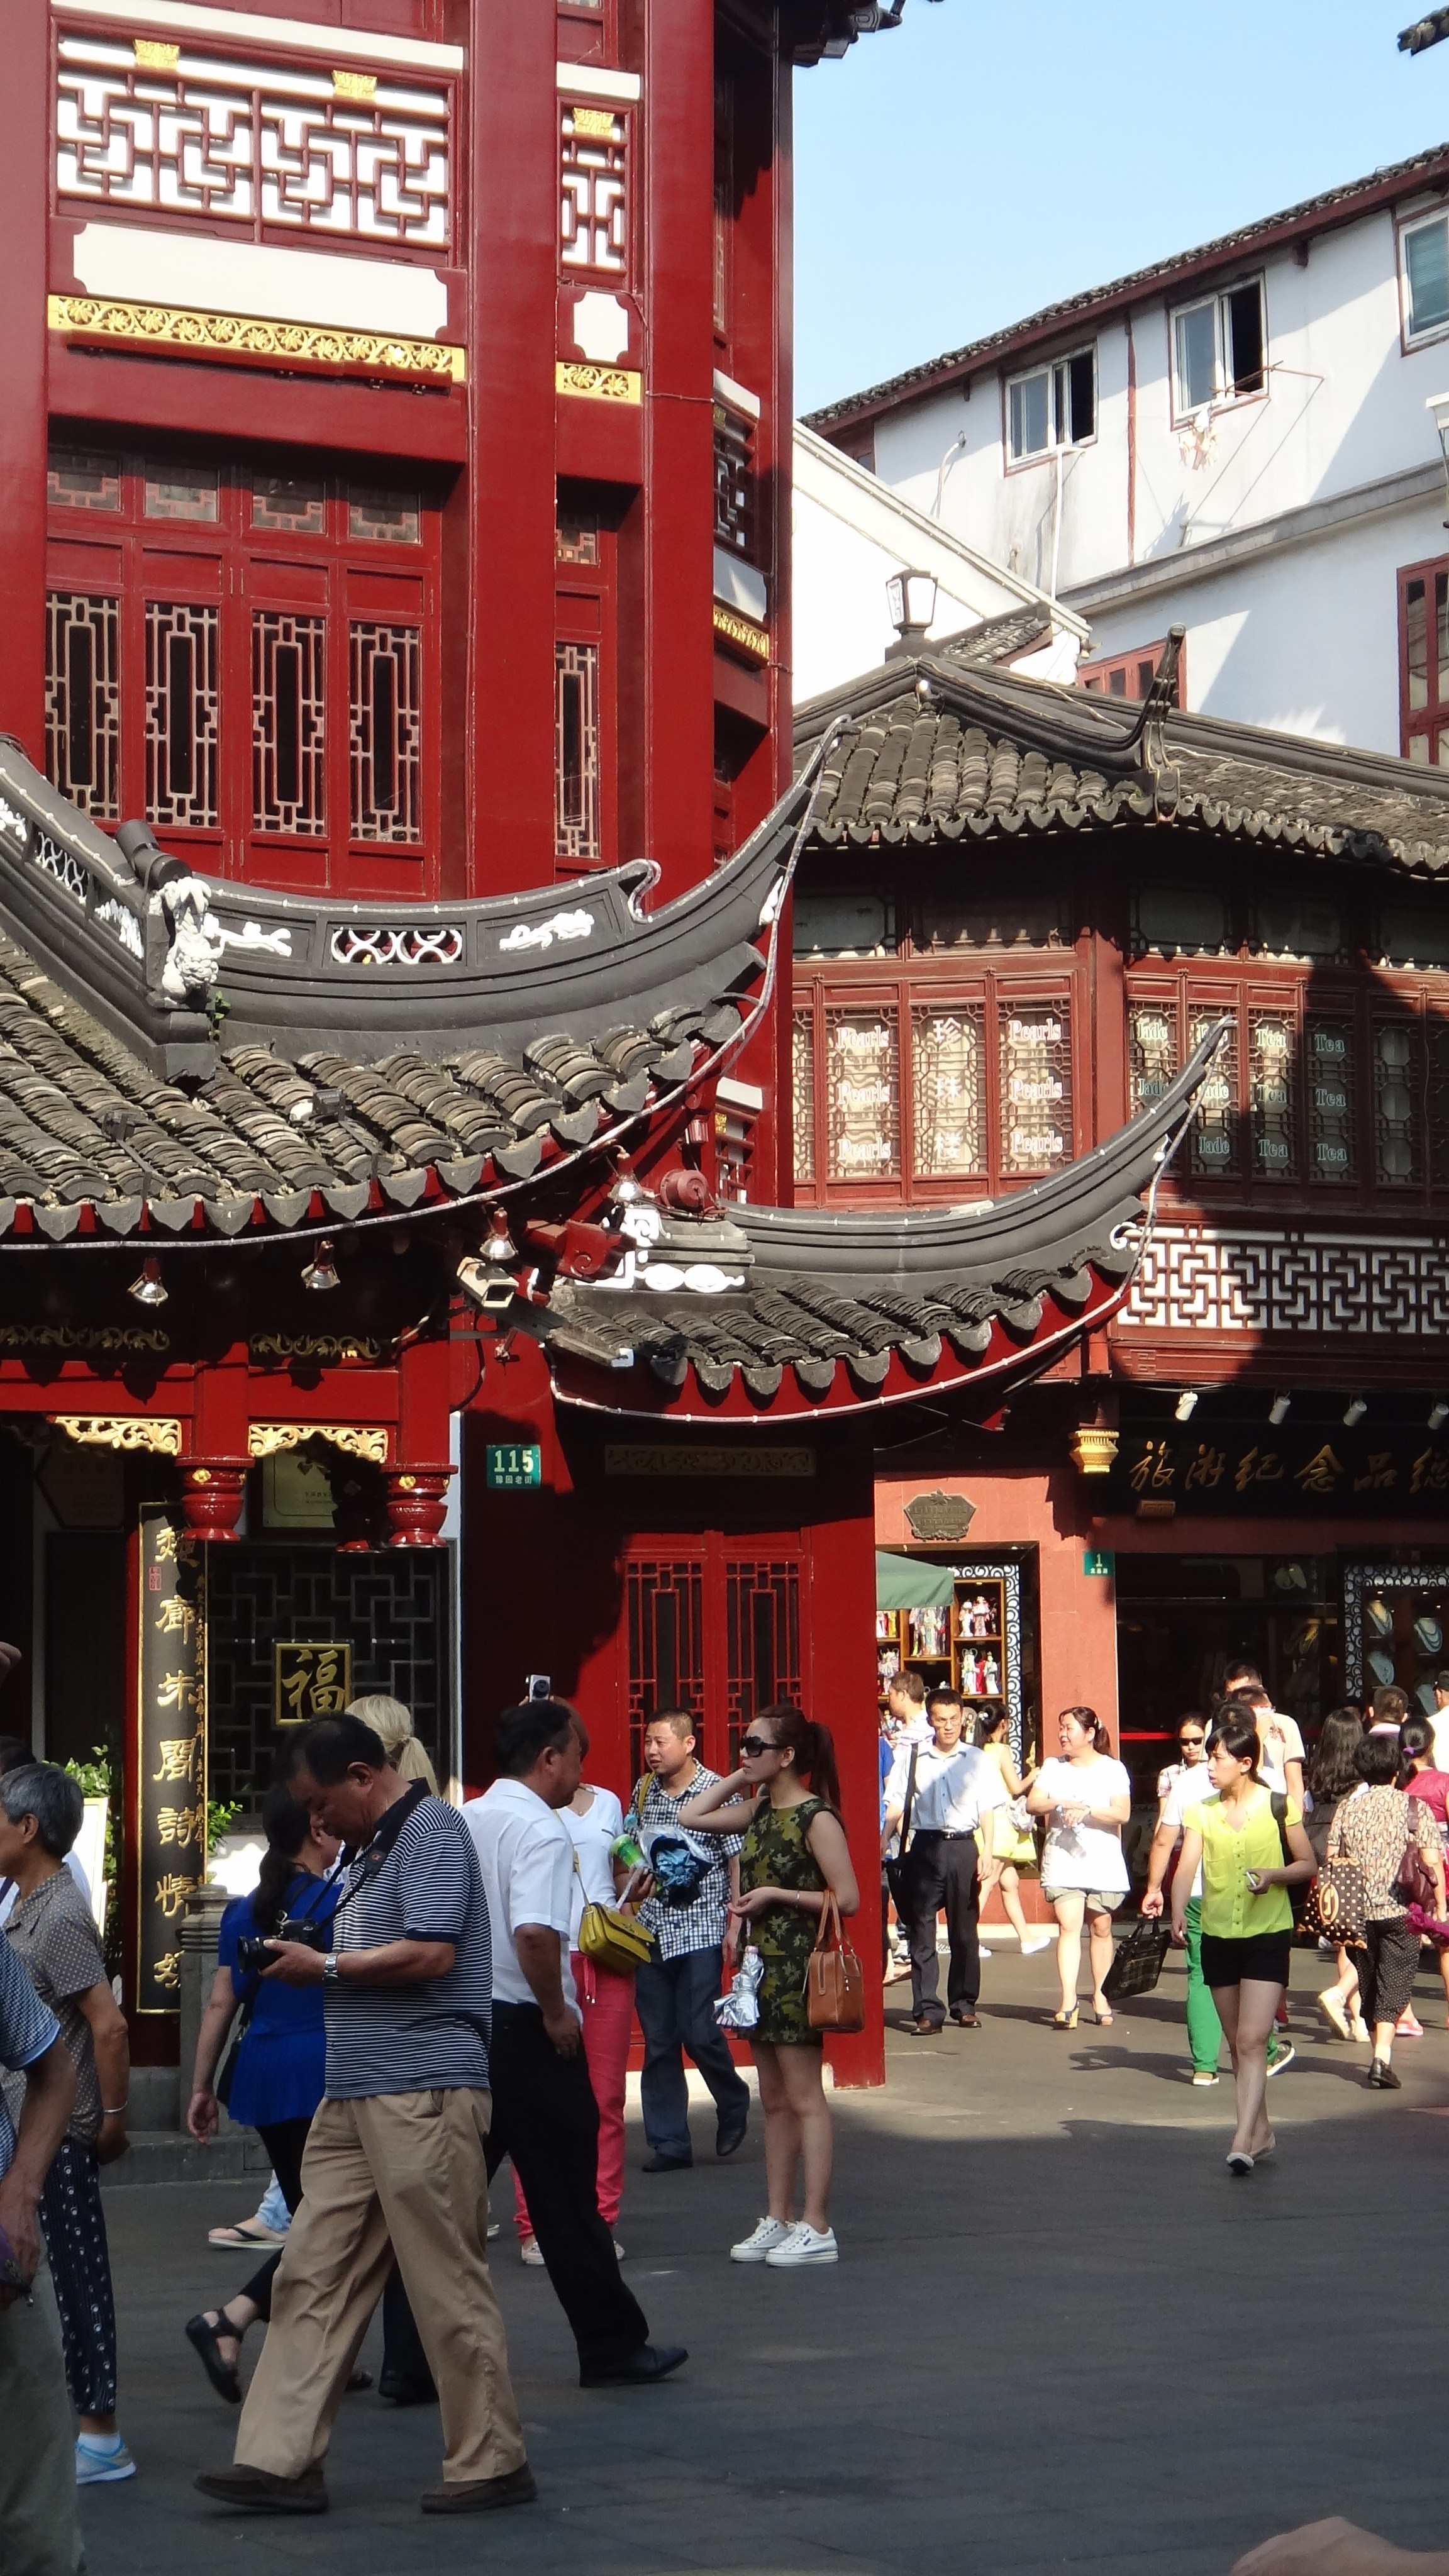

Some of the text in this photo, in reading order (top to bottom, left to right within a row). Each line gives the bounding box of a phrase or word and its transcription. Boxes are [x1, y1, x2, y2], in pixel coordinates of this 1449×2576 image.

[836, 1025, 890, 1048] Pearls
[1008, 1018, 1062, 1041] Pearls
[1136, 1023, 1168, 1040] Jade
[1255, 1028, 1287, 1047] Tea
[1314, 1034, 1345, 1052] Tea
[836, 1080, 891, 1105] Pearls
[932, 1017, 962, 1160] 珍珠楼
[1009, 1076, 1063, 1100] Pearls
[1257, 1084, 1287, 1103] Tea
[1315, 1089, 1346, 1107] Tea
[837, 1137, 891, 1160] Pearls
[1010, 1130, 1063, 1153] Pearls
[1199, 1136, 1230, 1153] Jade
[1258, 1139, 1289, 1157] Tea
[1316, 1143, 1347, 1162] Tea
[494, 1450, 533, 1472] 115
[1096, 1553, 1102, 1567] 1
[281, 1648, 346, 1719] 福
